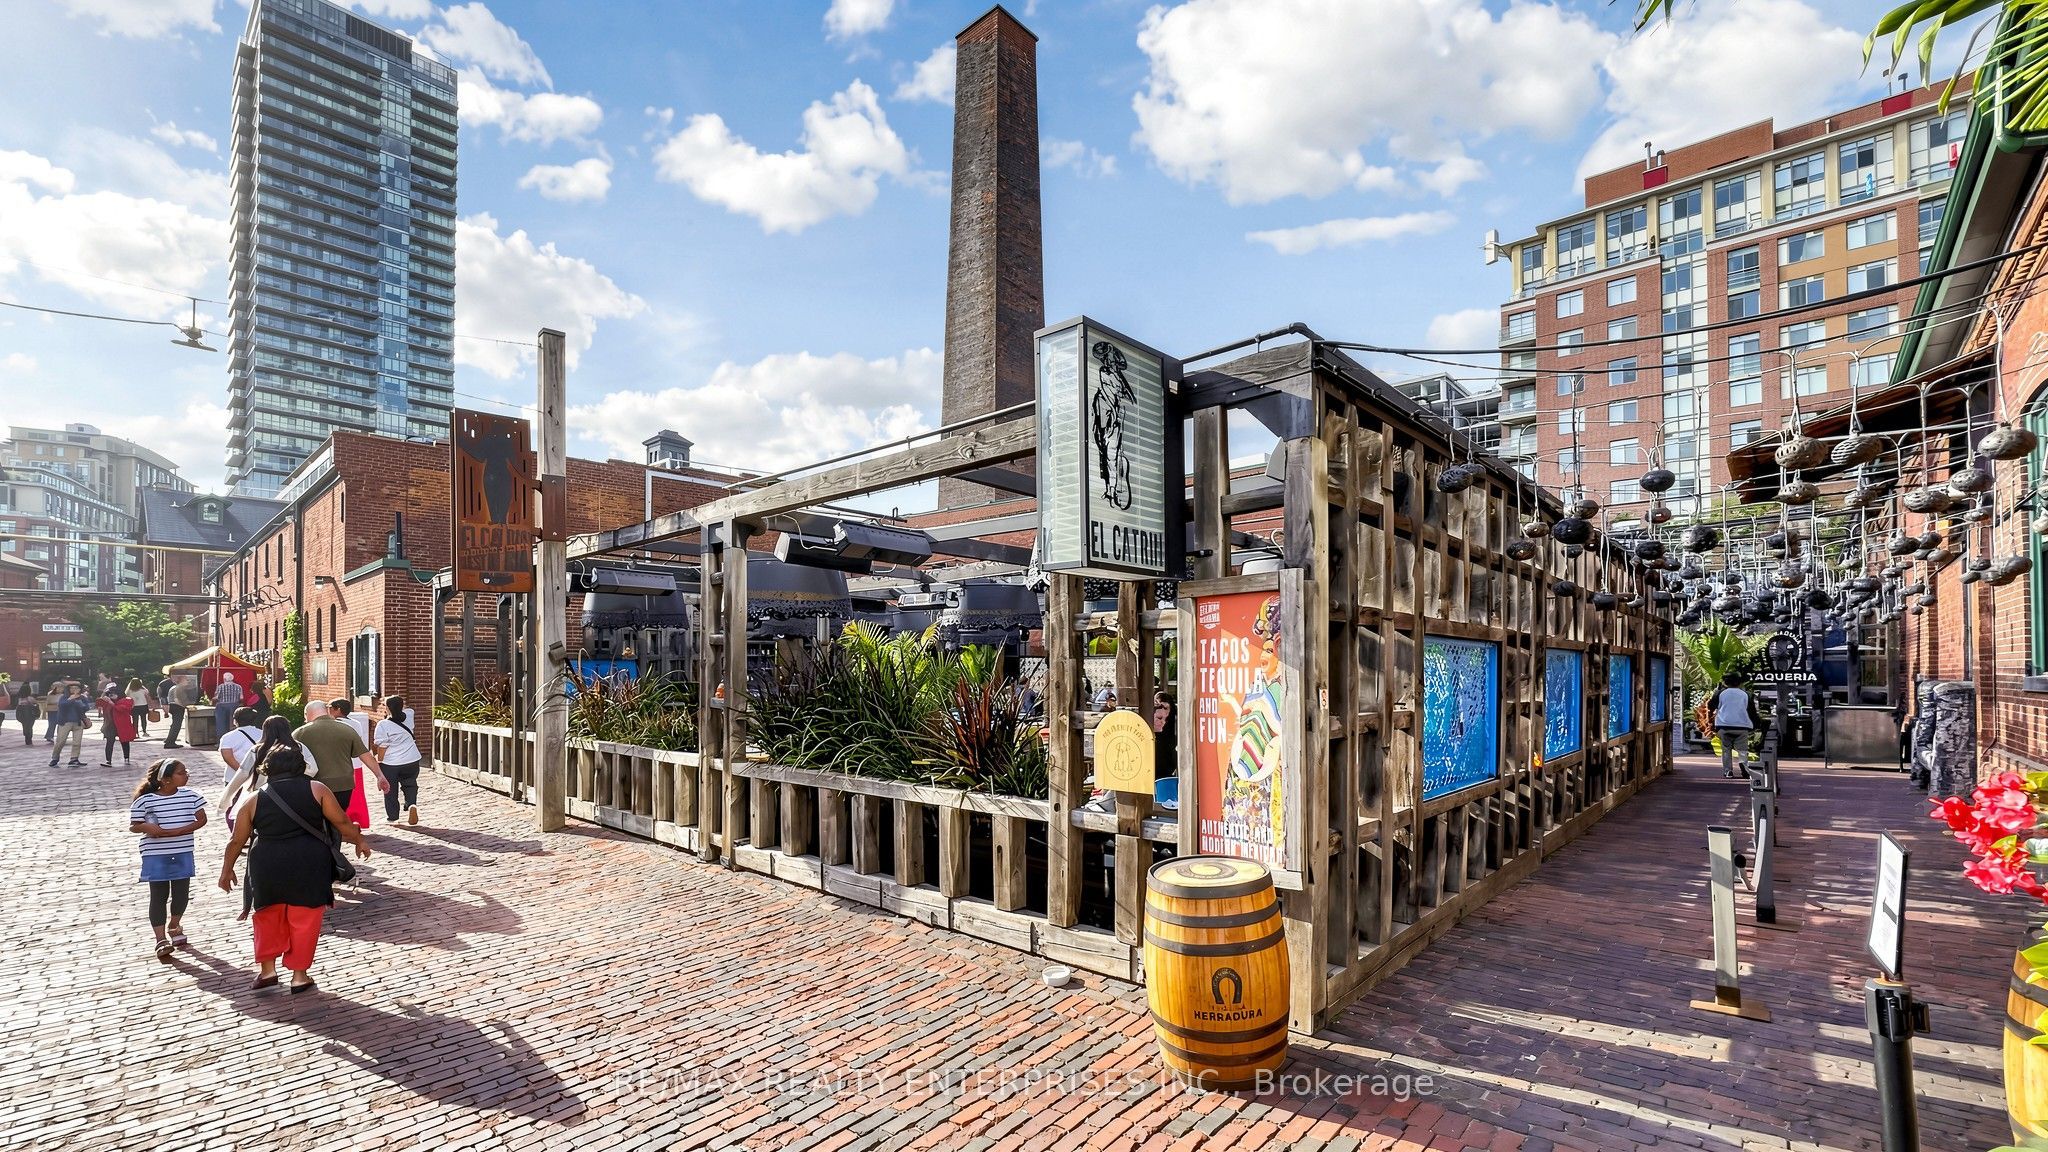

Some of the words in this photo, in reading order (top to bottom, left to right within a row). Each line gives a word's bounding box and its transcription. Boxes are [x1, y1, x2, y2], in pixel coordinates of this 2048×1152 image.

[1091, 520, 1108, 559] EL
[1200, 637, 1250, 665] TACOS
[1200, 667, 1263, 694] TEQUILA
[1747, 672, 1817, 681] TAQUERIA
[1200, 717, 1227, 743] FUN
[1194, 1008, 1263, 1022] HERRADURA
